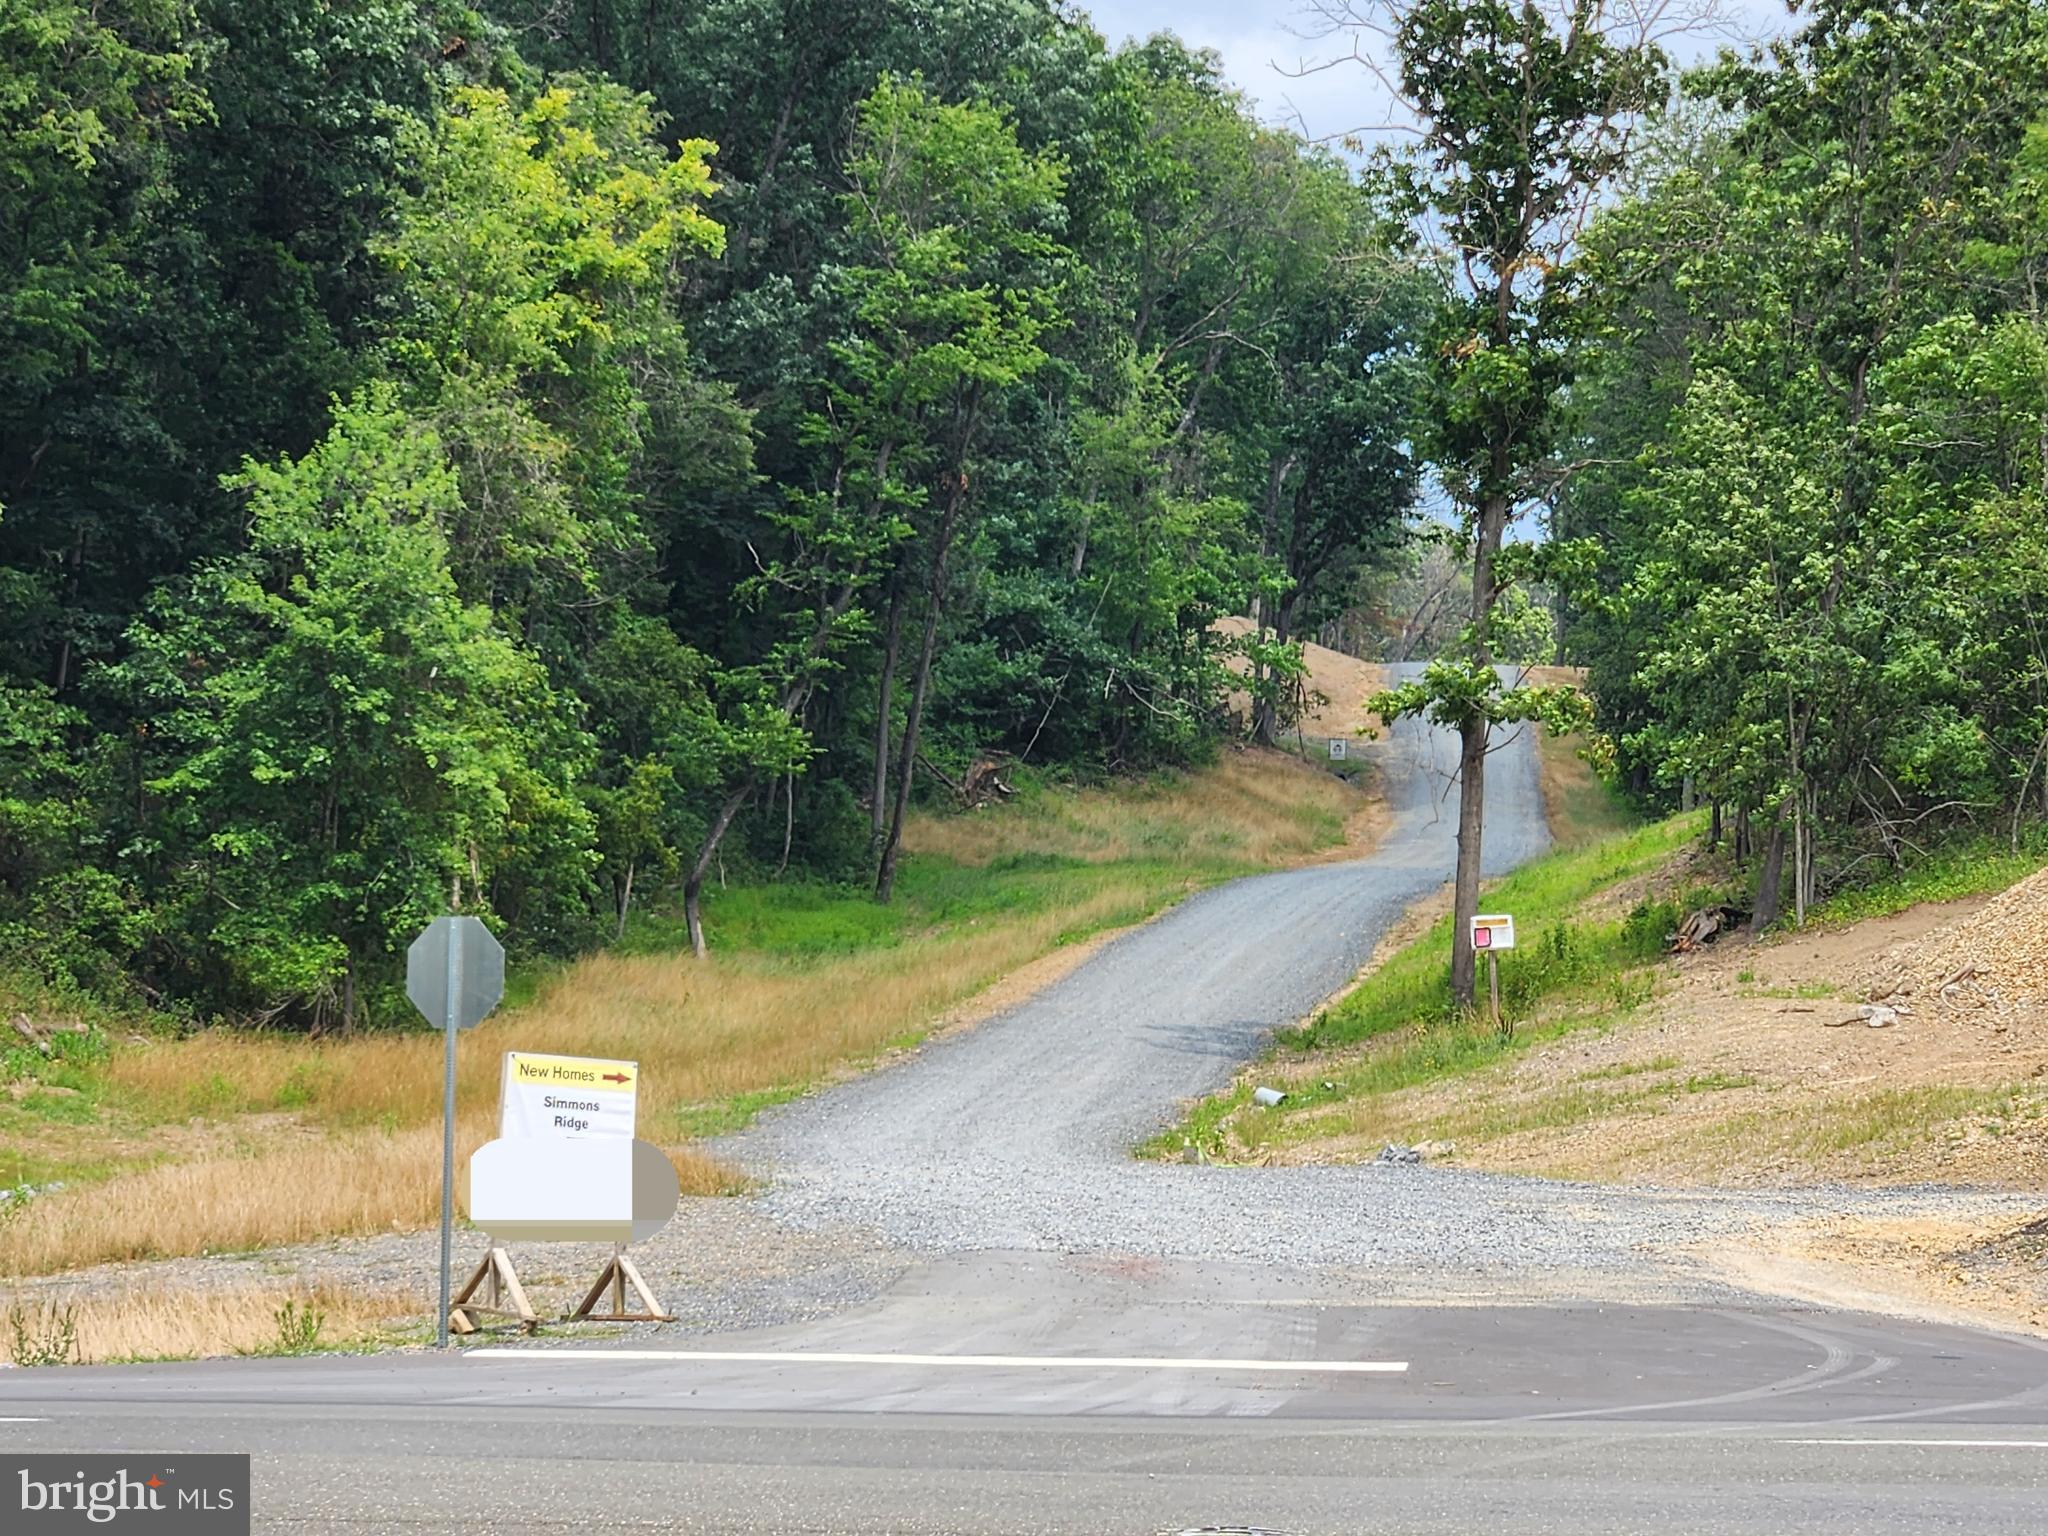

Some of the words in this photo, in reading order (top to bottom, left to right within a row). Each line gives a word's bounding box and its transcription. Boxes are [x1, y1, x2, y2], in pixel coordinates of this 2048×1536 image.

[520, 1063, 549, 1078] New
[553, 1066, 595, 1081] Homes
[544, 1096, 600, 1111] Simmons
[554, 1116, 588, 1131] Ridge
